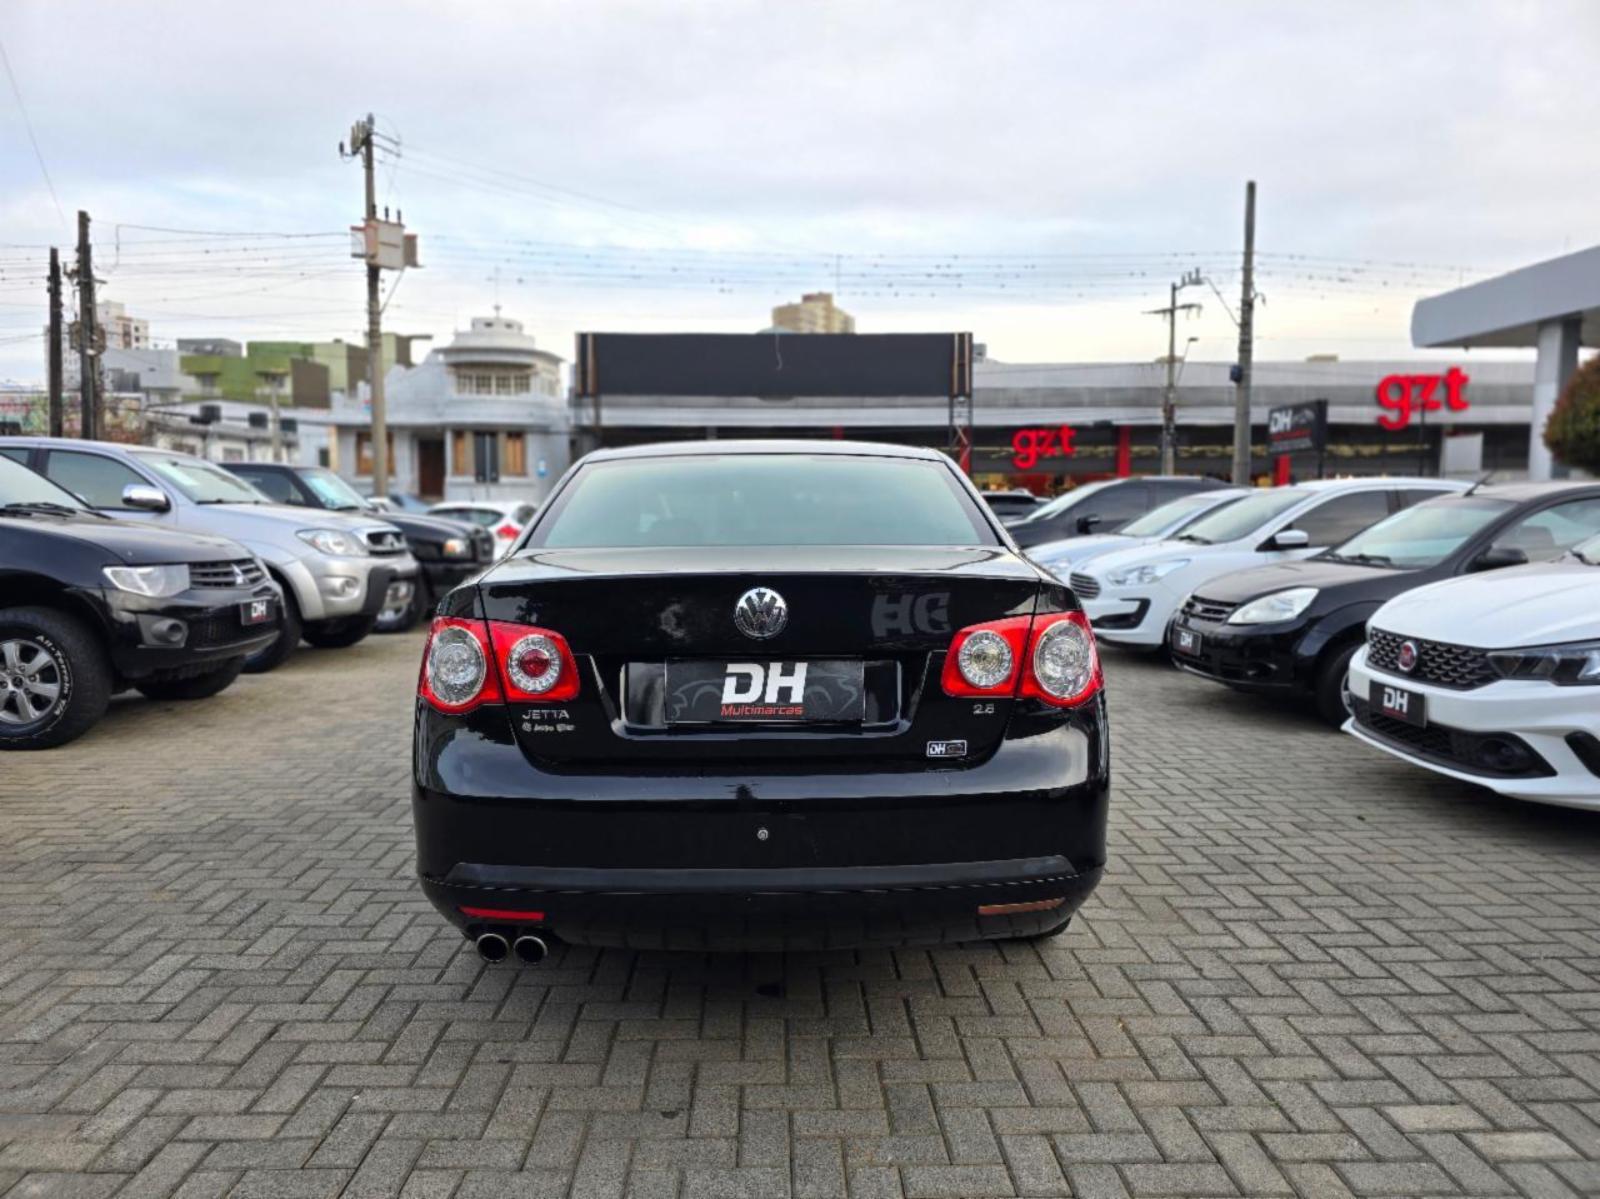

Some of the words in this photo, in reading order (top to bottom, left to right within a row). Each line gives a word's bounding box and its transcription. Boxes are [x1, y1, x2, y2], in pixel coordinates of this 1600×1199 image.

[1377, 367, 1469, 430] gzt
[1270, 409, 1292, 433] DH
[1012, 424, 1076, 469] gzt
[721, 662, 808, 704] DH
[721, 704, 804, 716] Multimarcas
[1383, 687, 1409, 714] DH
[522, 709, 570, 719] JETTA
[929, 743, 946, 755] DH
